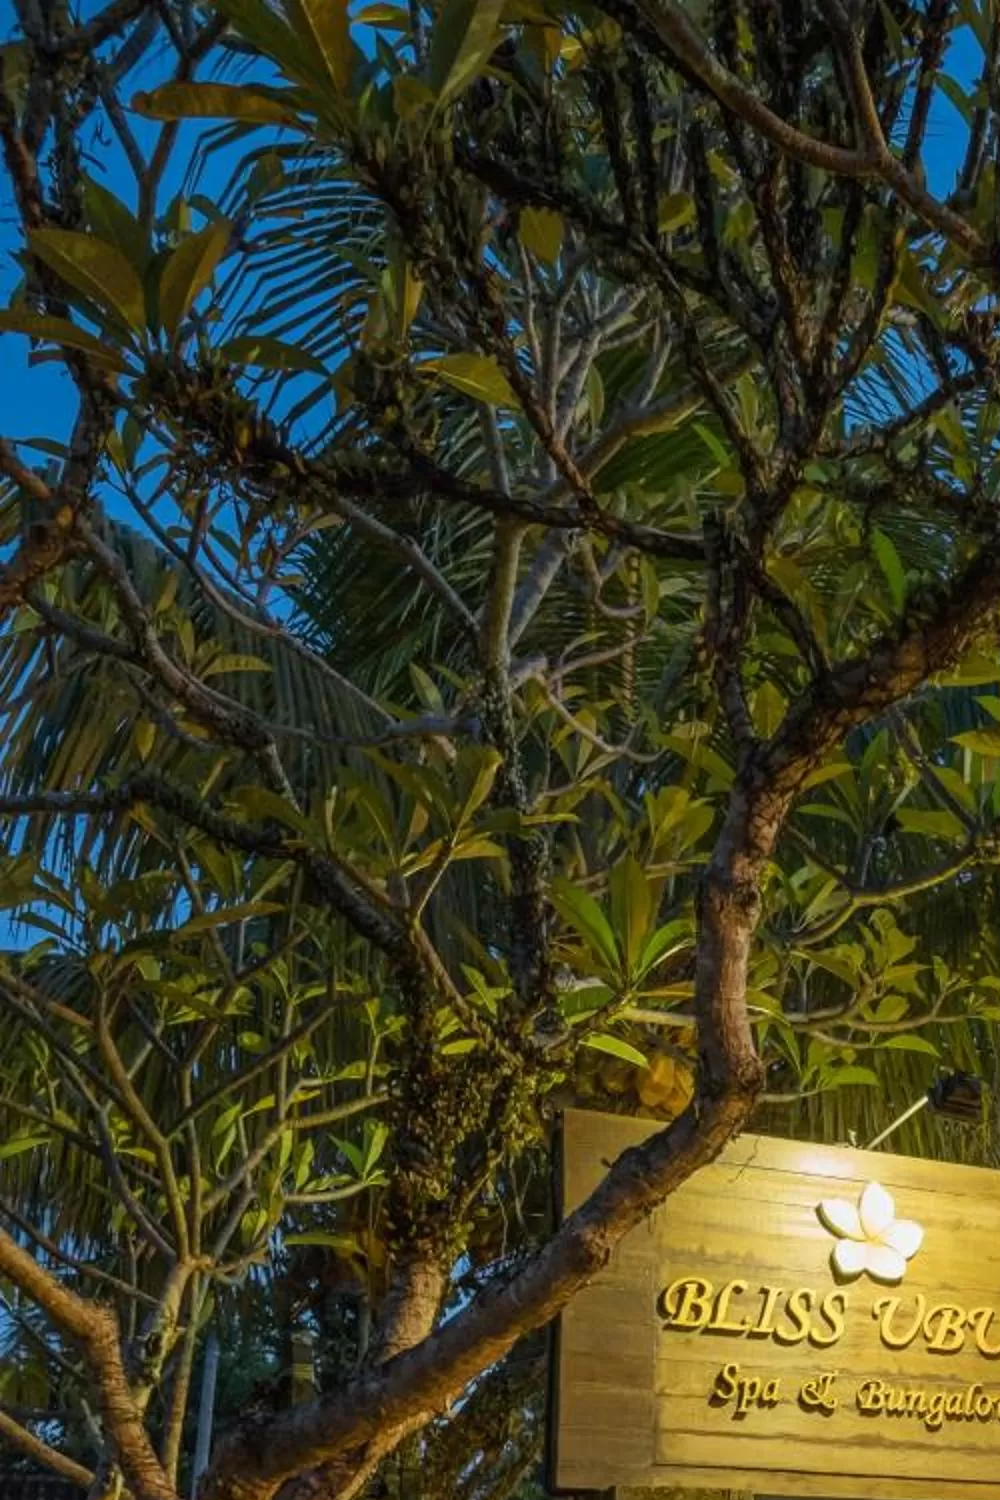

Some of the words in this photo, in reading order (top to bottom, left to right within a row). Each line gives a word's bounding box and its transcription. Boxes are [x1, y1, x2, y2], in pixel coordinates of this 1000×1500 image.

[663, 1277, 848, 1344] BLISS
[714, 1363, 781, 1412] Spa
[801, 1371, 838, 1409] &
